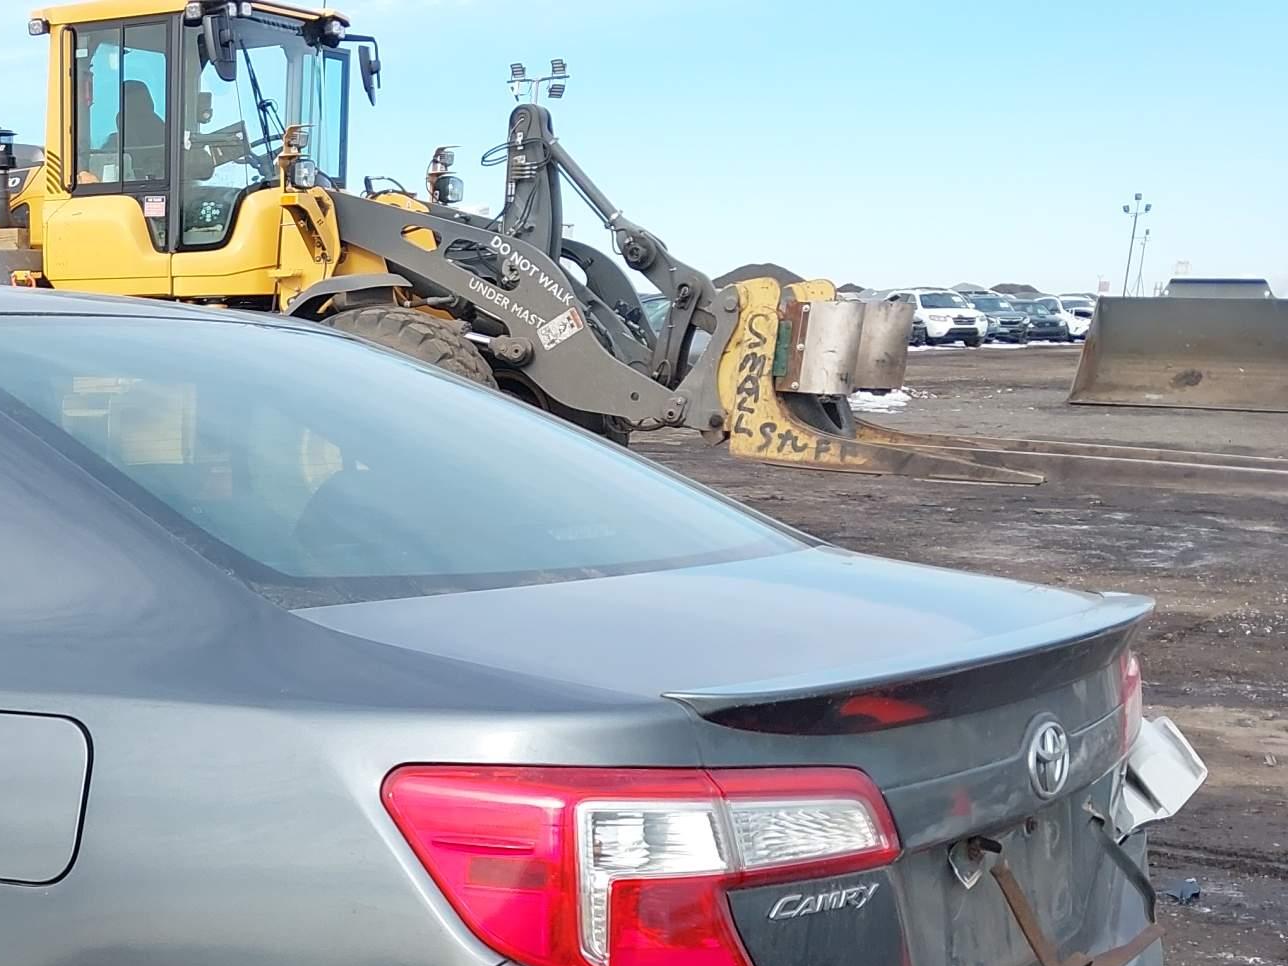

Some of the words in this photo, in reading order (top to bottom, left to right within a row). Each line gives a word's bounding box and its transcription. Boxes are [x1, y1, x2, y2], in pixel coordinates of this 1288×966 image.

[491, 235, 511, 255] DO
[510, 251, 540, 277] NOT
[538, 272, 574, 306] WALK
[468, 277, 510, 310] UNDER
[511, 303, 546, 329] MAST
[768, 883, 880, 920] CAMRY
